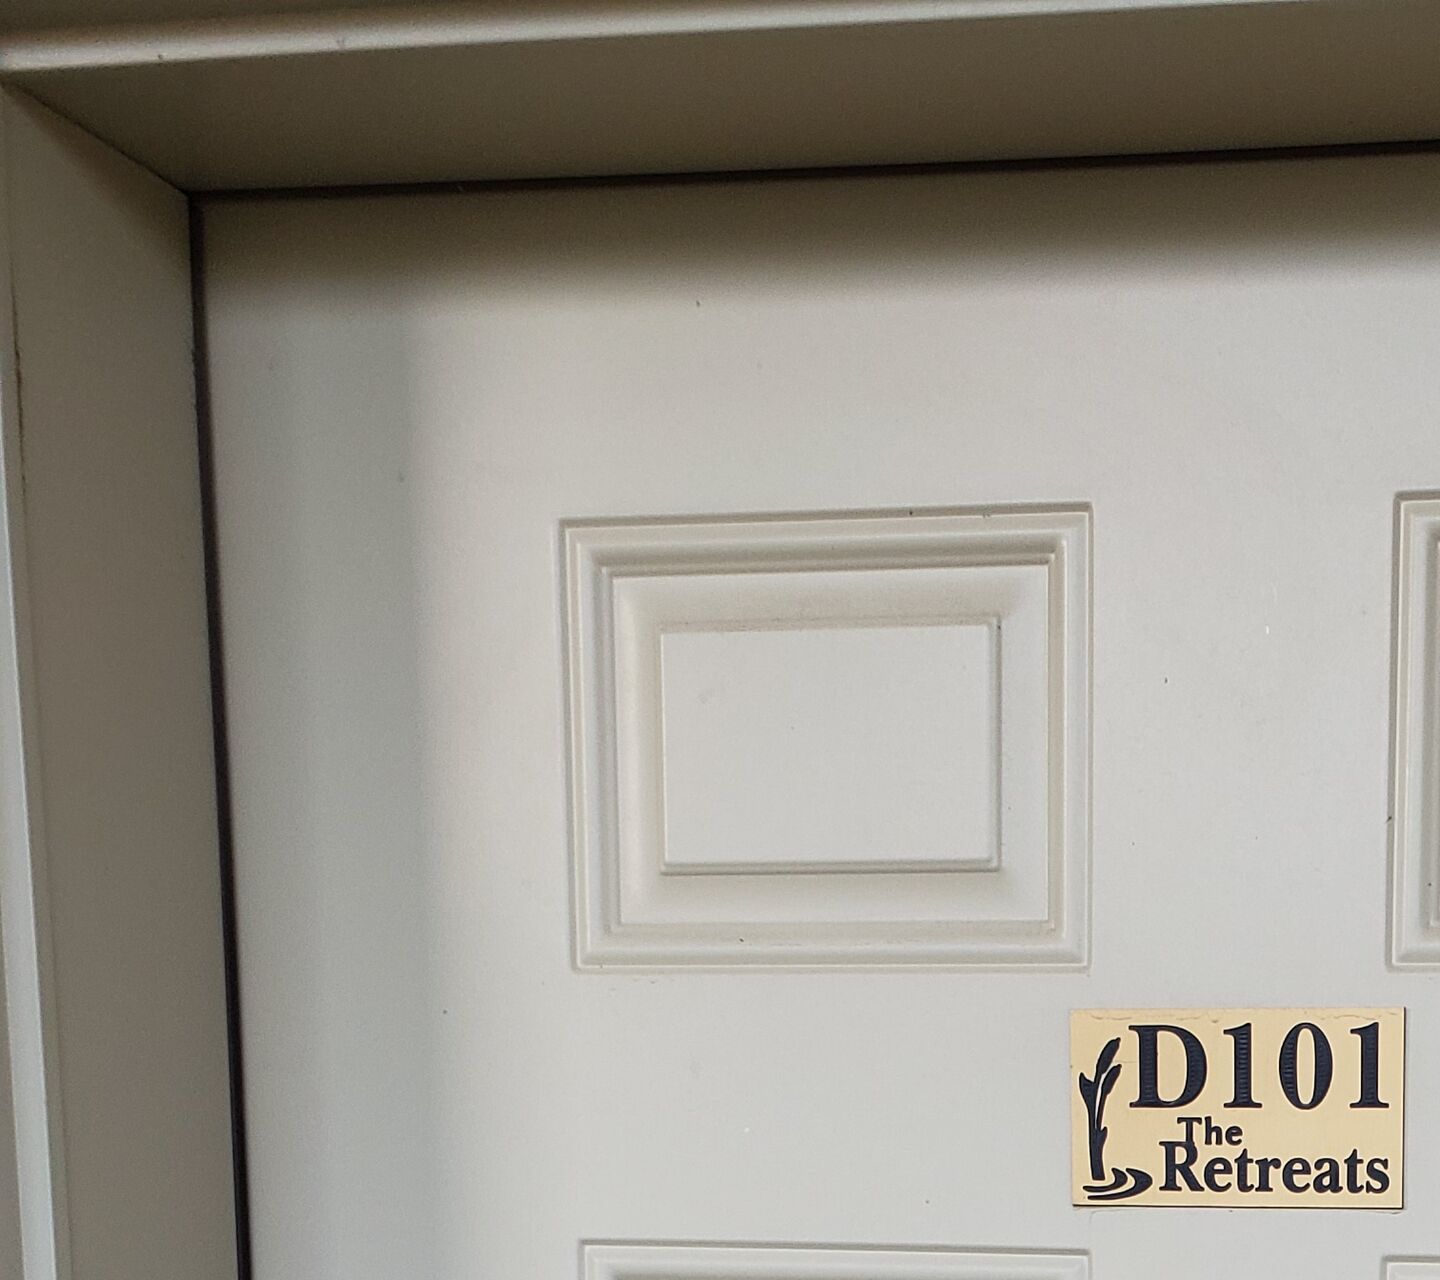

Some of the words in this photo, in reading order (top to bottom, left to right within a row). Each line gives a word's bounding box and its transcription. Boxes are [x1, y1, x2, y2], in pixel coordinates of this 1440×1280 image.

[1128, 1021, 1390, 1110] D101
[1176, 1115, 1244, 1147] The
[1158, 1140, 1391, 1195] Retreats
